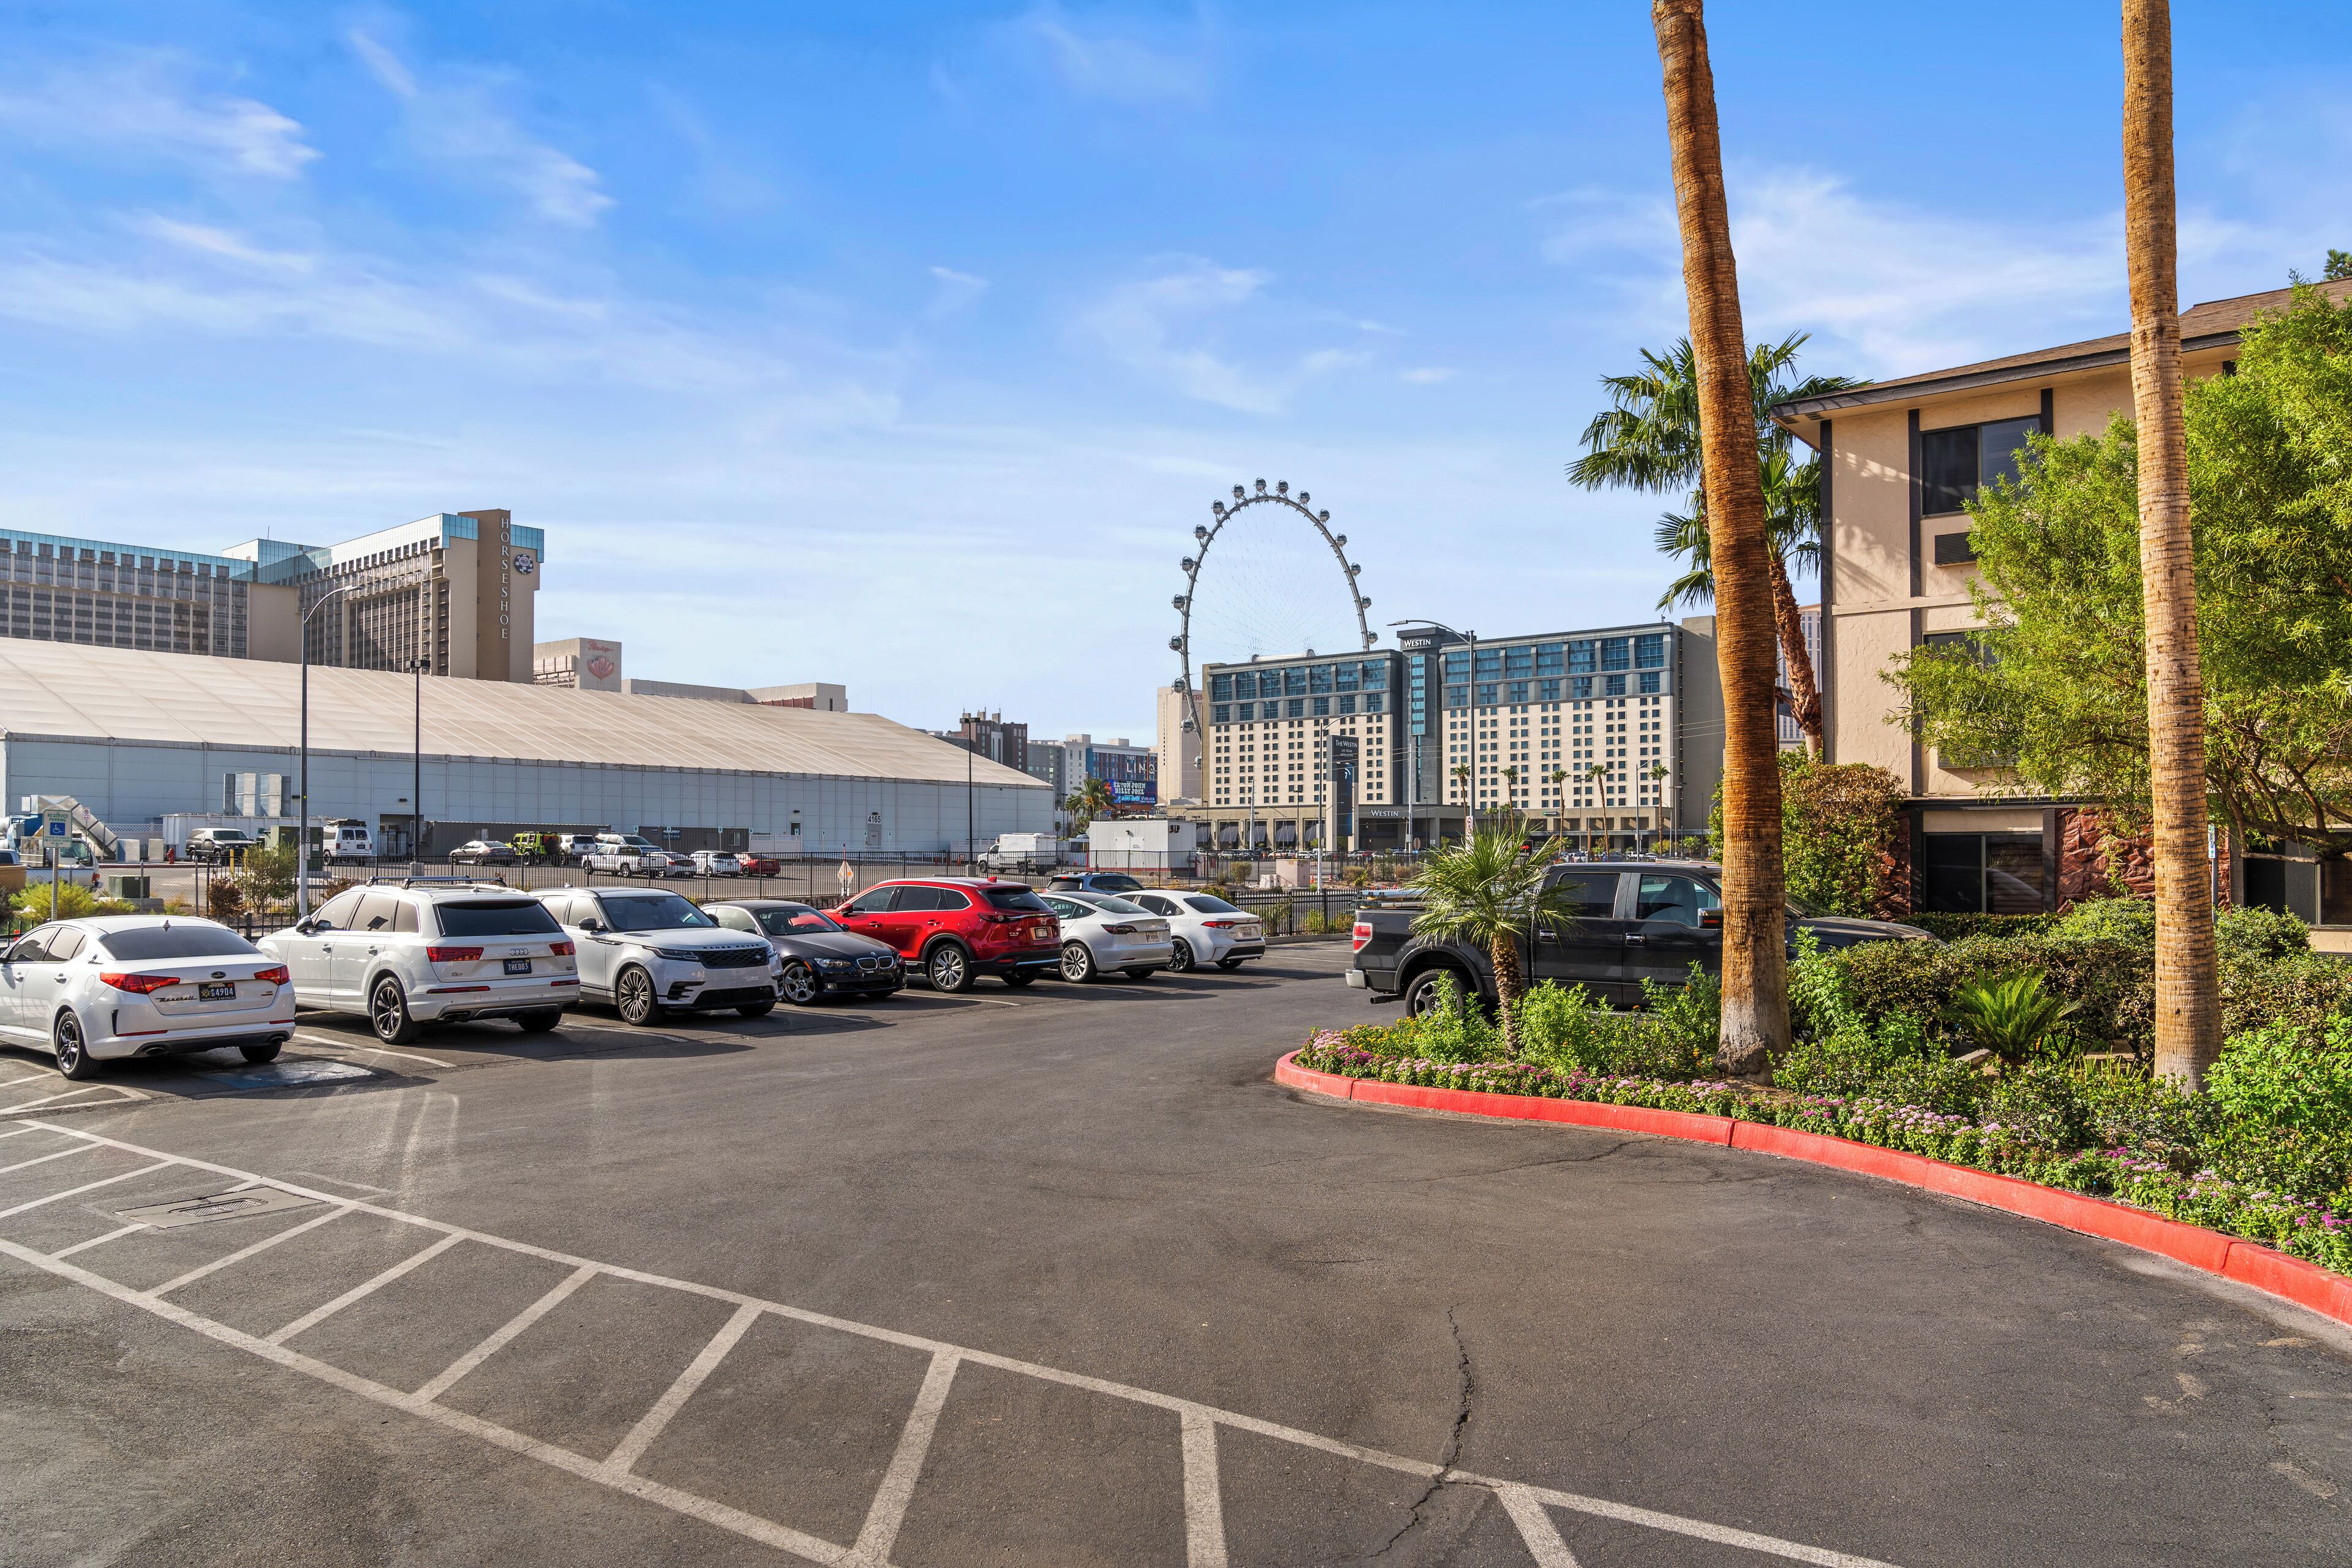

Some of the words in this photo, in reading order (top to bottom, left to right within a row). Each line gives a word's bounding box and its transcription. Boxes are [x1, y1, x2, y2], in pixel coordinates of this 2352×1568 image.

[500, 518, 510, 639] HORSESHOE
[1404, 639, 1431, 647] WESTIN
[1127, 763, 1155, 774] LINQ
[216, 987, 233, 996] 4904
